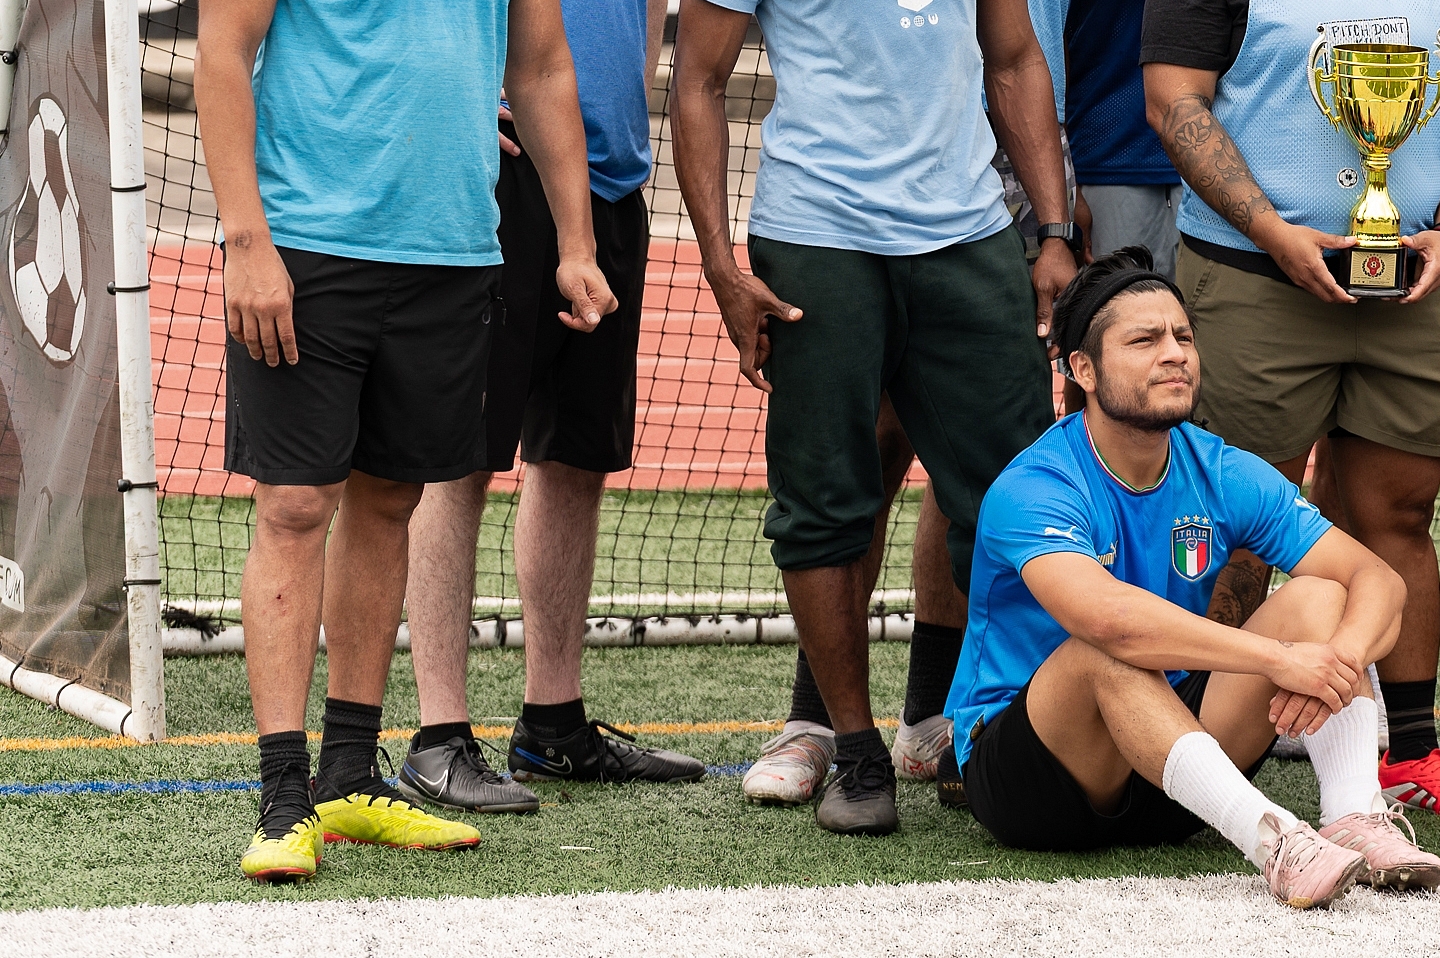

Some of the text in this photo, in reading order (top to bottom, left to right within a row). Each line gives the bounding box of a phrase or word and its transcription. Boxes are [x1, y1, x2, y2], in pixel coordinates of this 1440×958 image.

[1331, 22, 1404, 38] PITCH DONT
[1175, 529, 1208, 539] ITALIA
[942, 782, 964, 791] NEM
